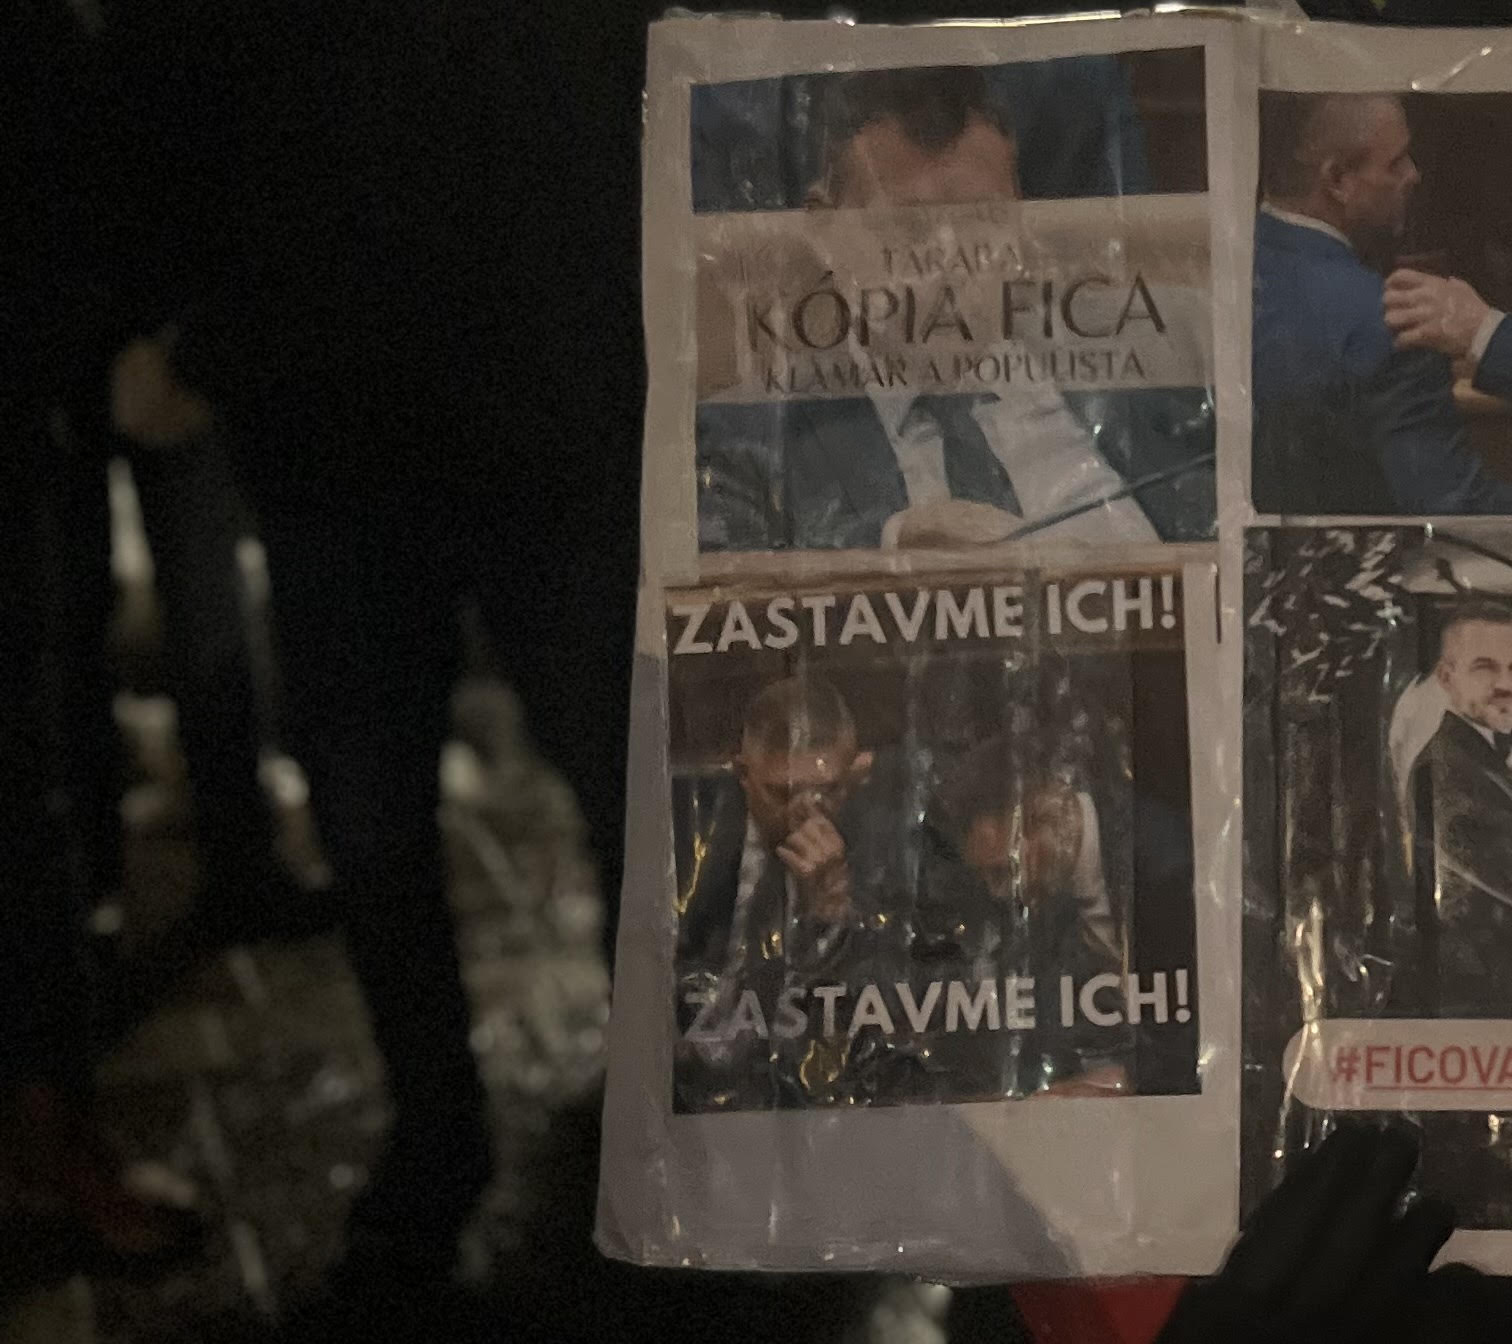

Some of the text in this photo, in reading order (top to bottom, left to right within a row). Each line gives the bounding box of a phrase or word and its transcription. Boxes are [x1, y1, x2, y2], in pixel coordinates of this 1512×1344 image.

[747, 269, 1167, 354] KÓPIA FICA
[953, 346, 1147, 384] POPULISTA
[672, 575, 1177, 654] ZASTAVME ICH!
[682, 967, 1193, 1043] ZASTAVME ICH!
